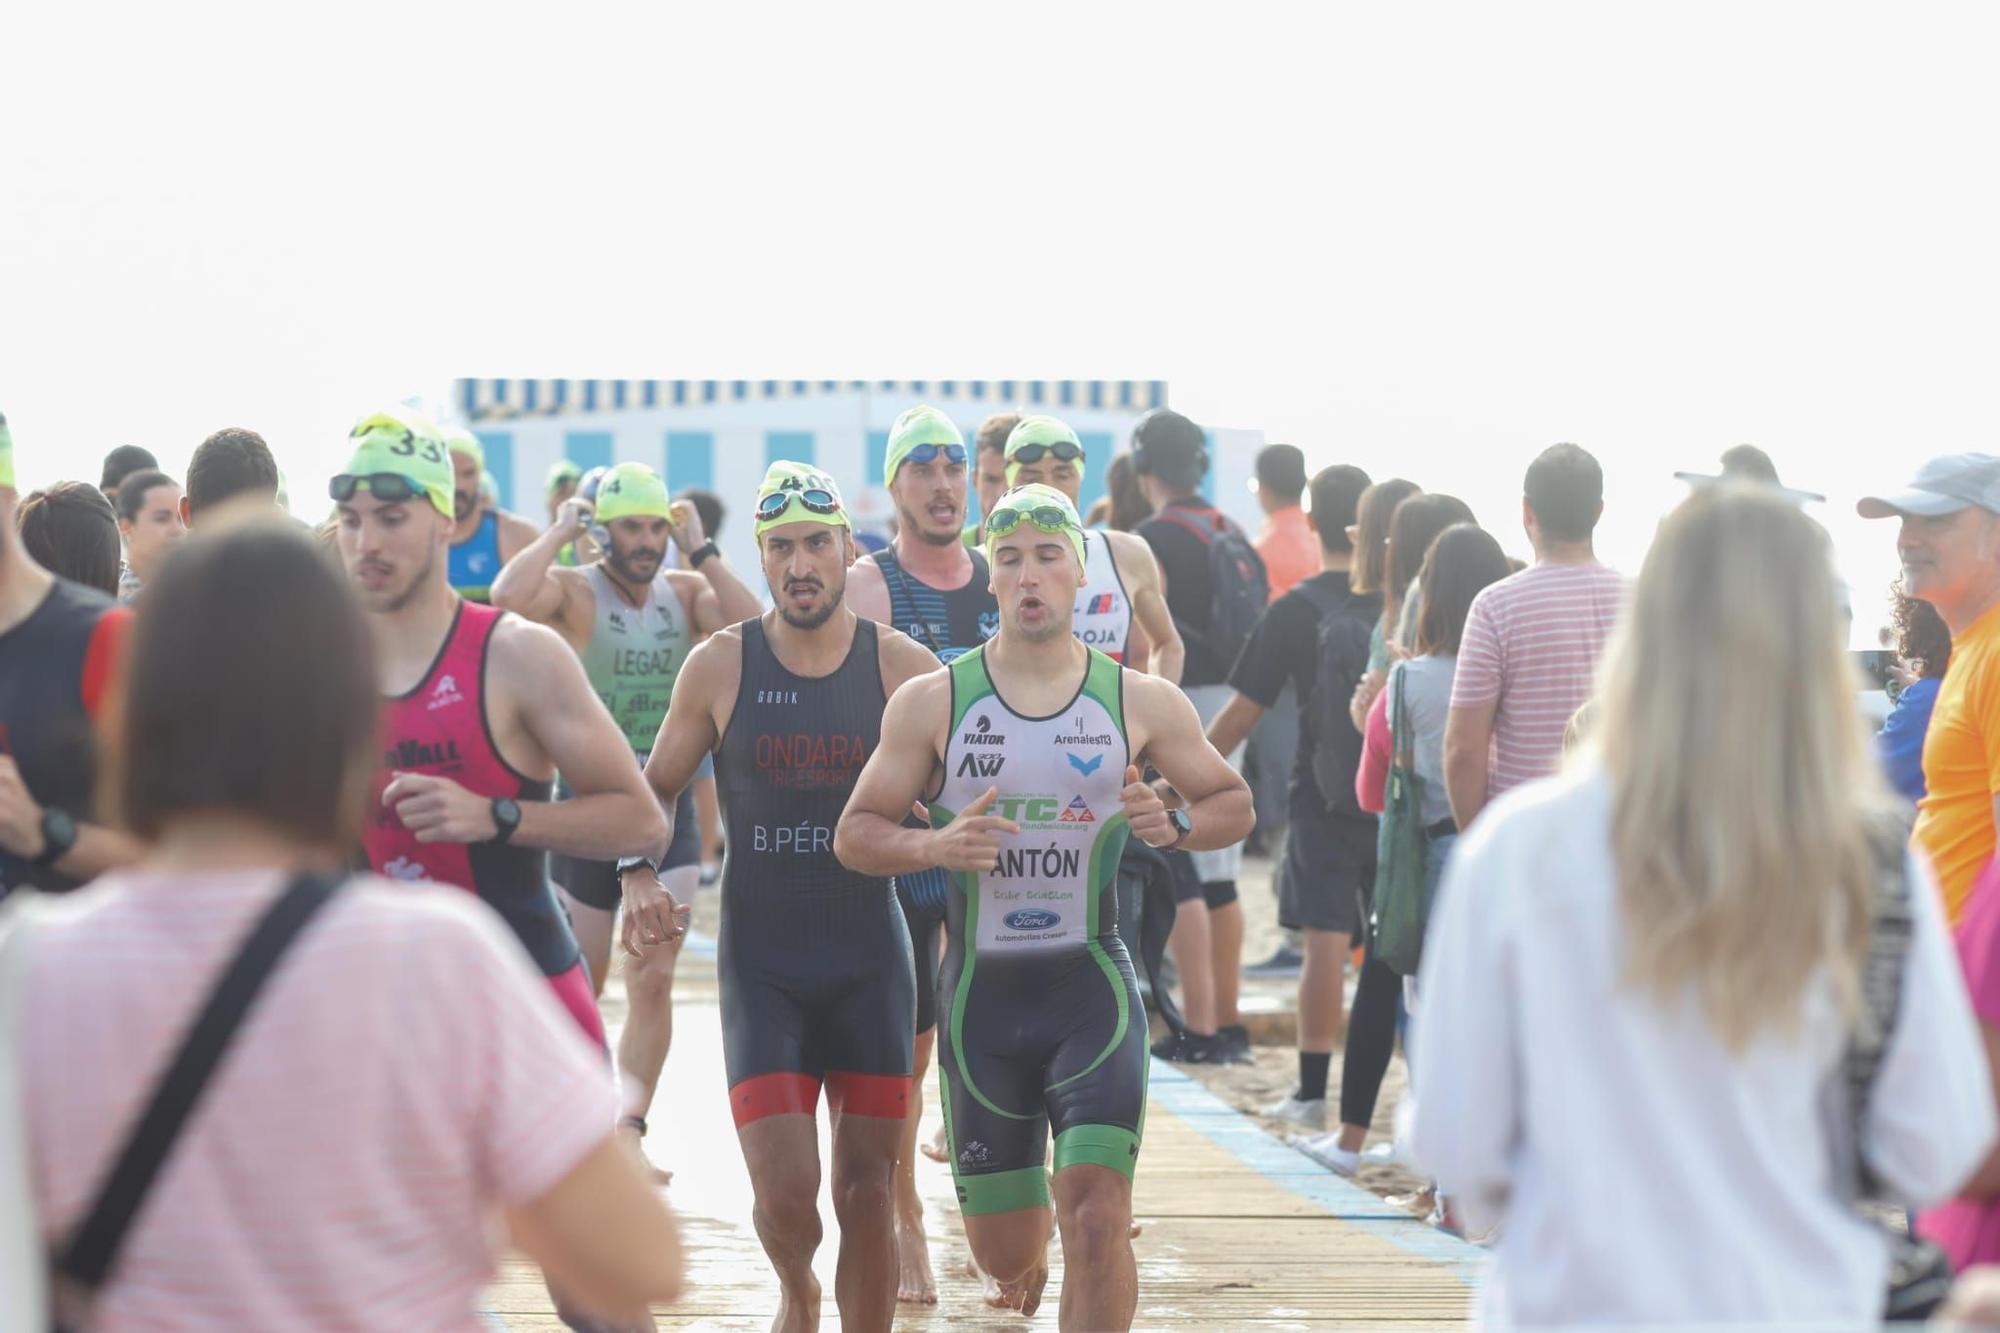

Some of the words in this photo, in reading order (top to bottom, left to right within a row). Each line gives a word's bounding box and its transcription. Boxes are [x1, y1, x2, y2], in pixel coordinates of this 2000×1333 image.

[614, 649, 672, 675] LEGAZ
[758, 690, 800, 704] GOBIK
[963, 733, 1006, 745] VIATOR
[1054, 734, 1112, 746] Arenales113
[756, 734, 865, 768] ONDARA
[754, 820, 837, 853] B.PÉR
[990, 842, 1080, 878] ANTÓN
[1014, 909, 1049, 927] Ford
